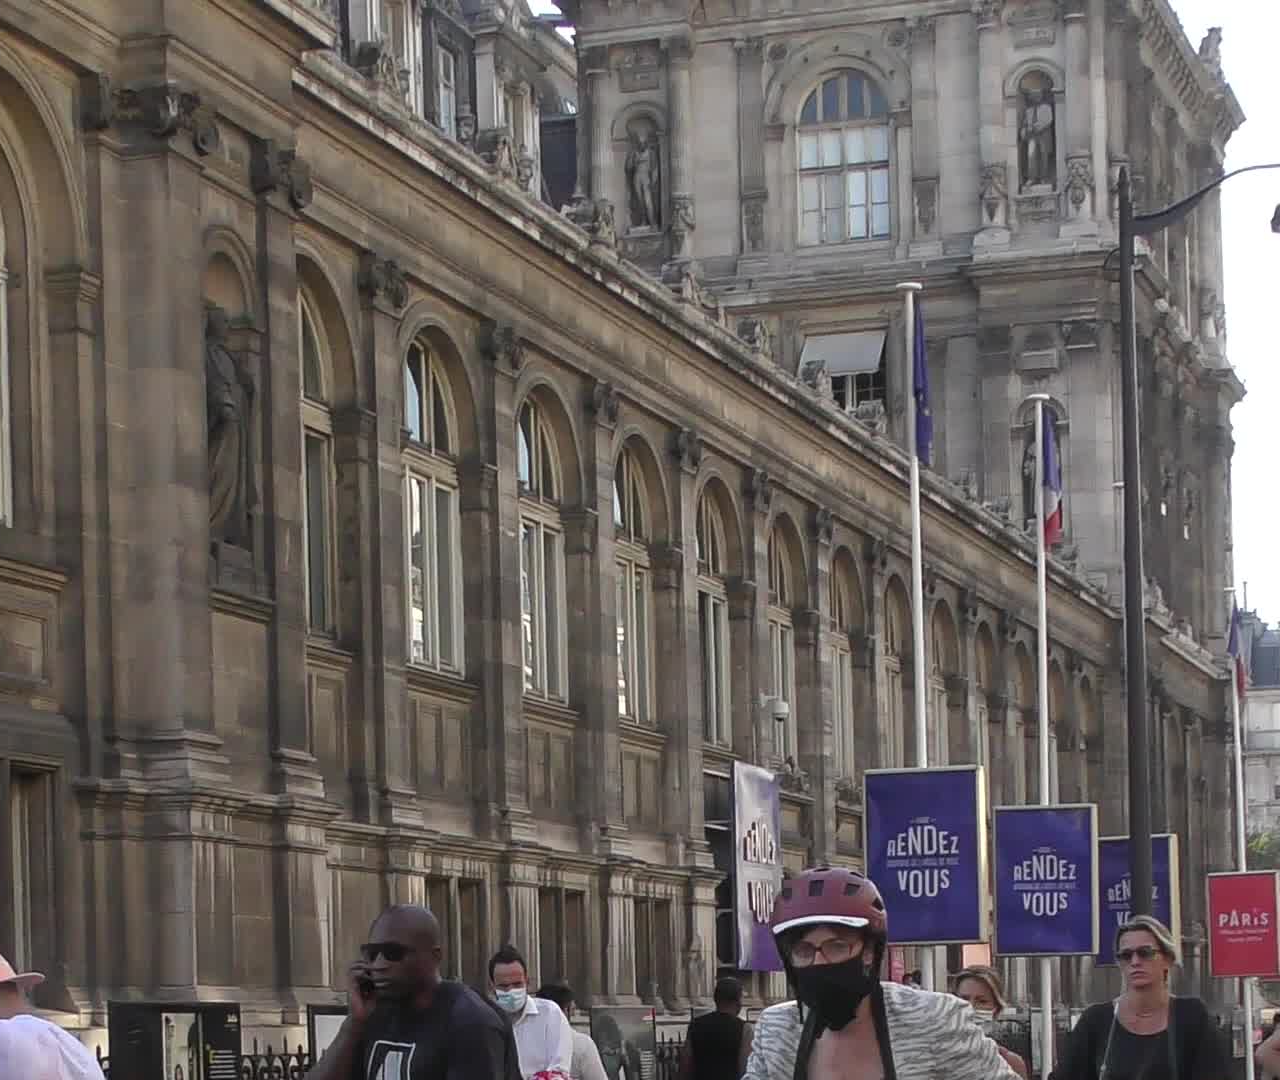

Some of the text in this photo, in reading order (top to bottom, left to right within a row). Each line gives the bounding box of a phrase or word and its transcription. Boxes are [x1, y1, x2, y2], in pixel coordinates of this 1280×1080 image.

[887, 825, 959, 857] RENDEZ
[1013, 855, 1076, 881] RENDEZ
[898, 868, 950, 898] VOUS
[1108, 879, 1159, 902] RENZ
[1022, 892, 1068, 917] VOUS
